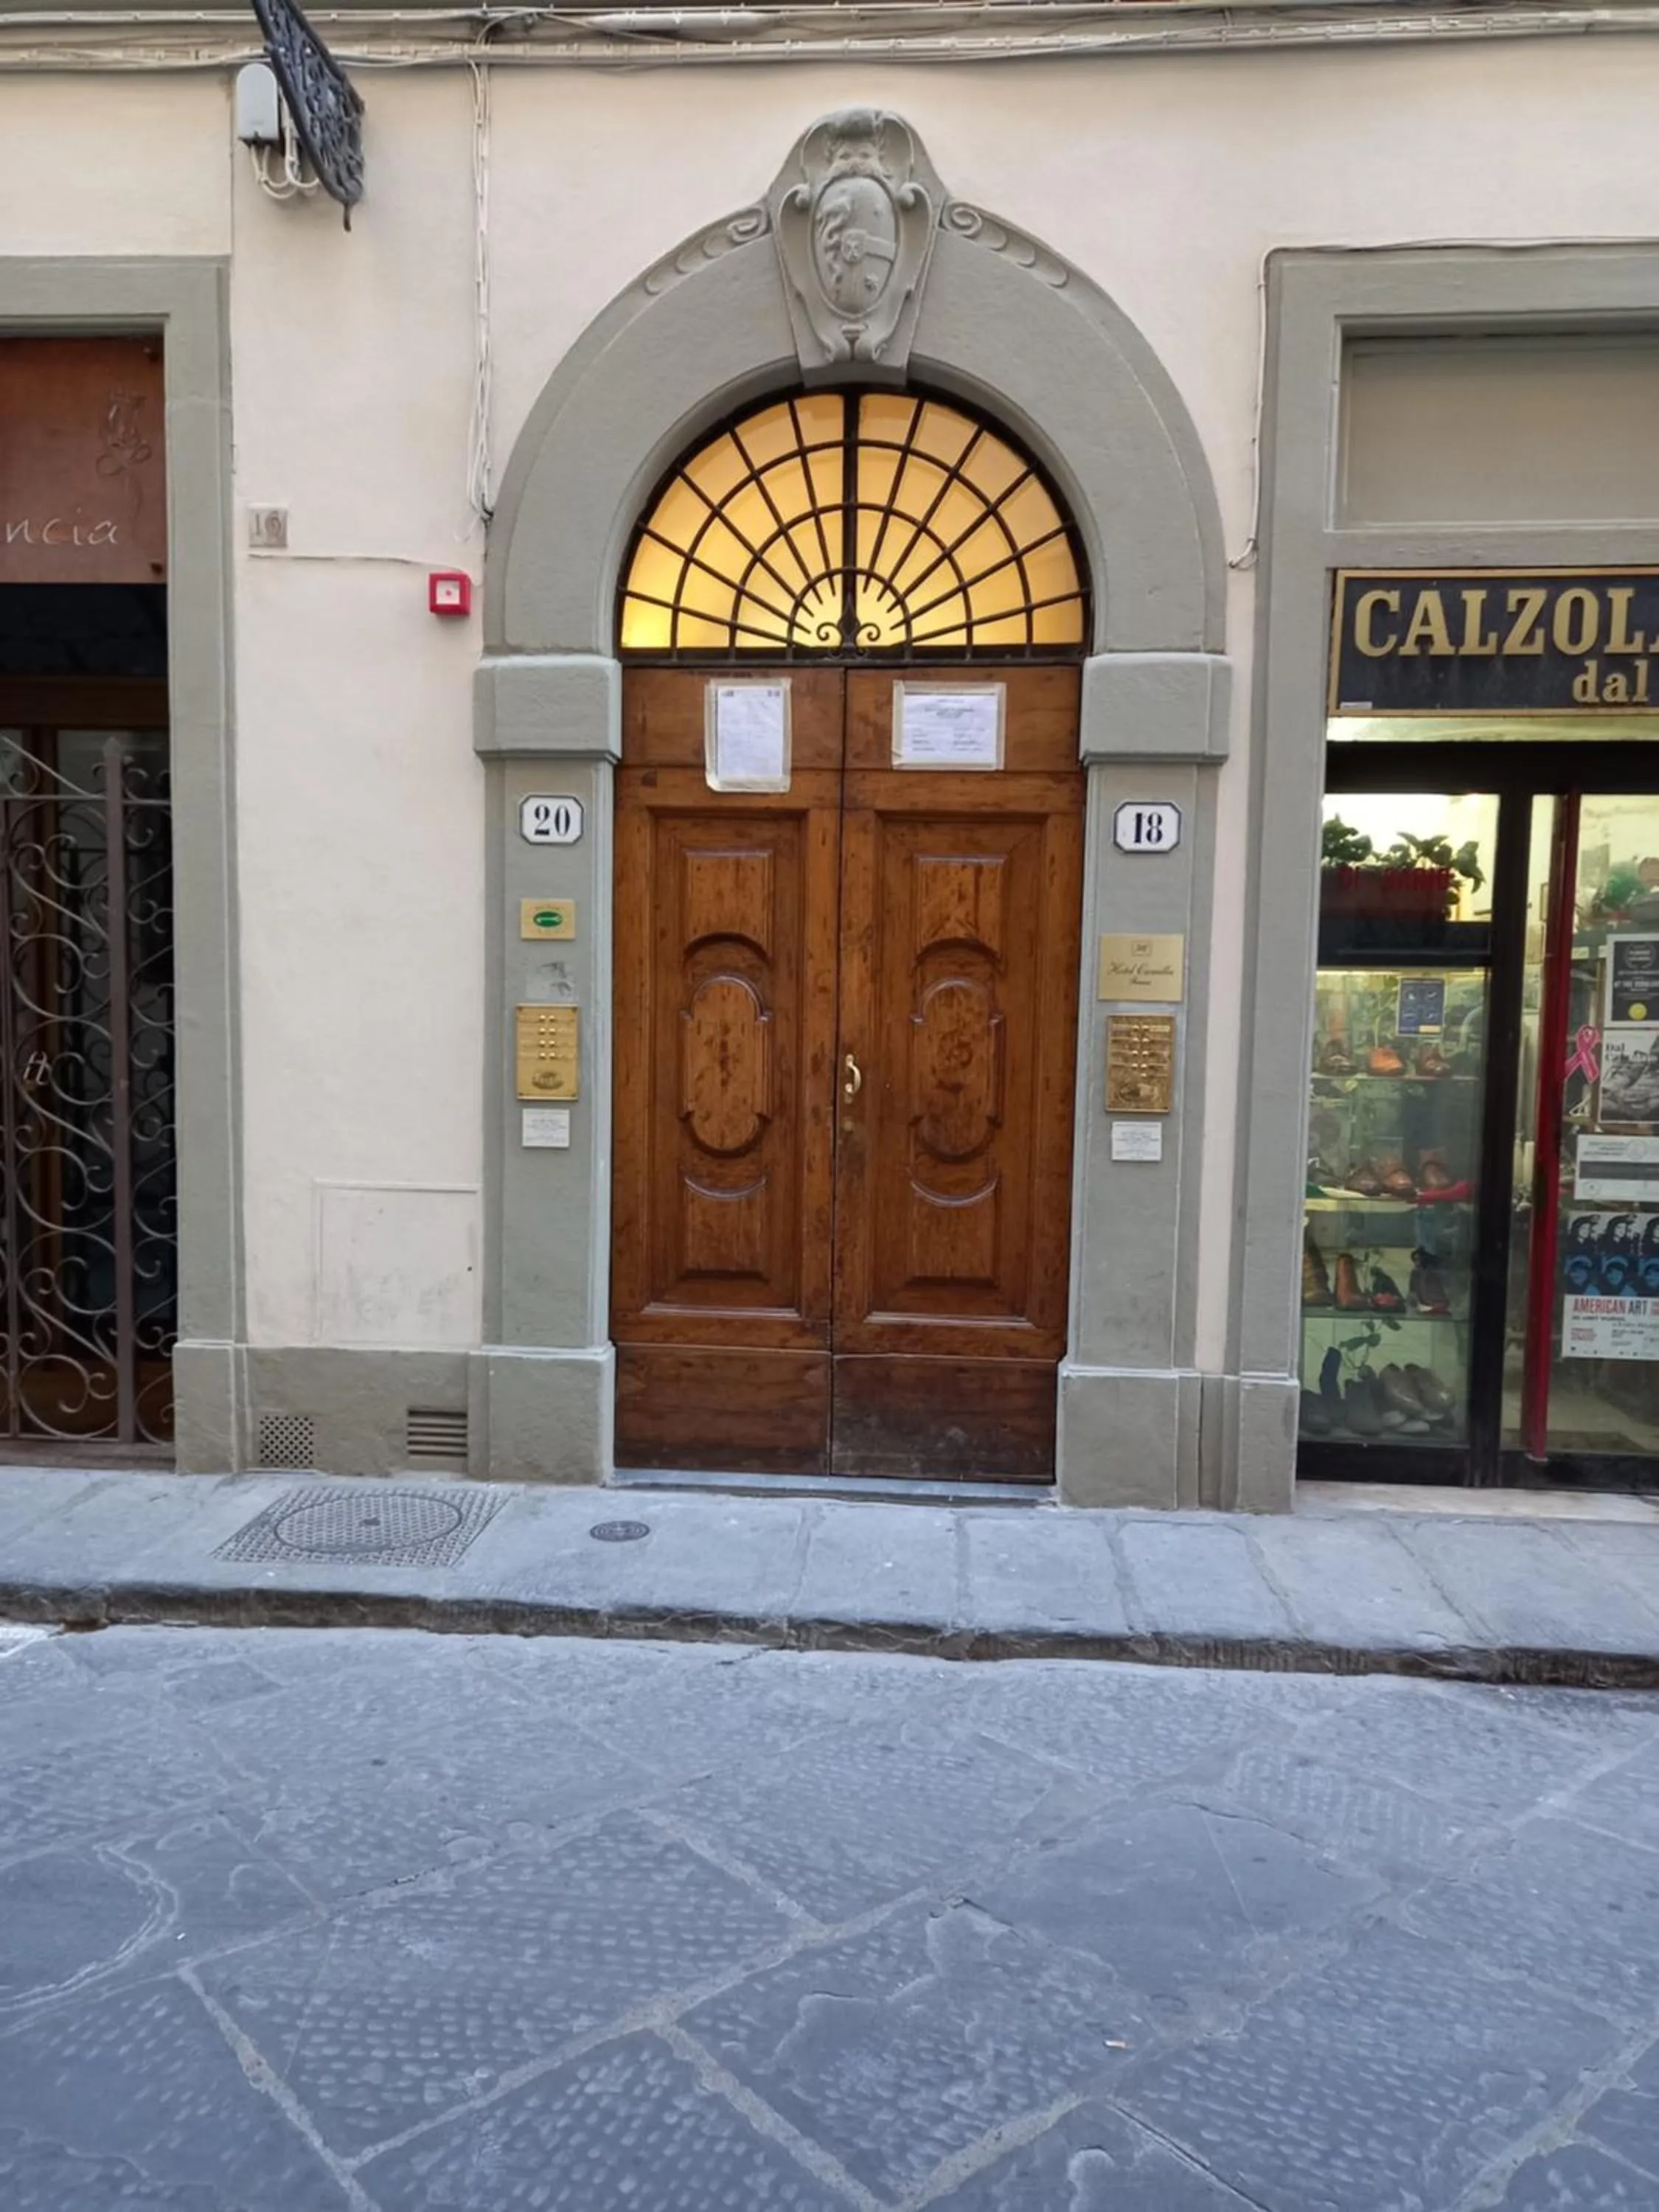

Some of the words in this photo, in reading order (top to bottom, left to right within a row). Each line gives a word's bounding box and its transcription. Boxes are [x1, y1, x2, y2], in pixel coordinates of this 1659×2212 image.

[1354, 588, 1659, 657] CALZOL
[1573, 659, 1650, 703] dal
[534, 804, 571, 837] 20
[1134, 812, 1163, 844] 18
[1572, 1298, 1627, 1315] AMERICAN
[1627, 1300, 1648, 1316] ART
